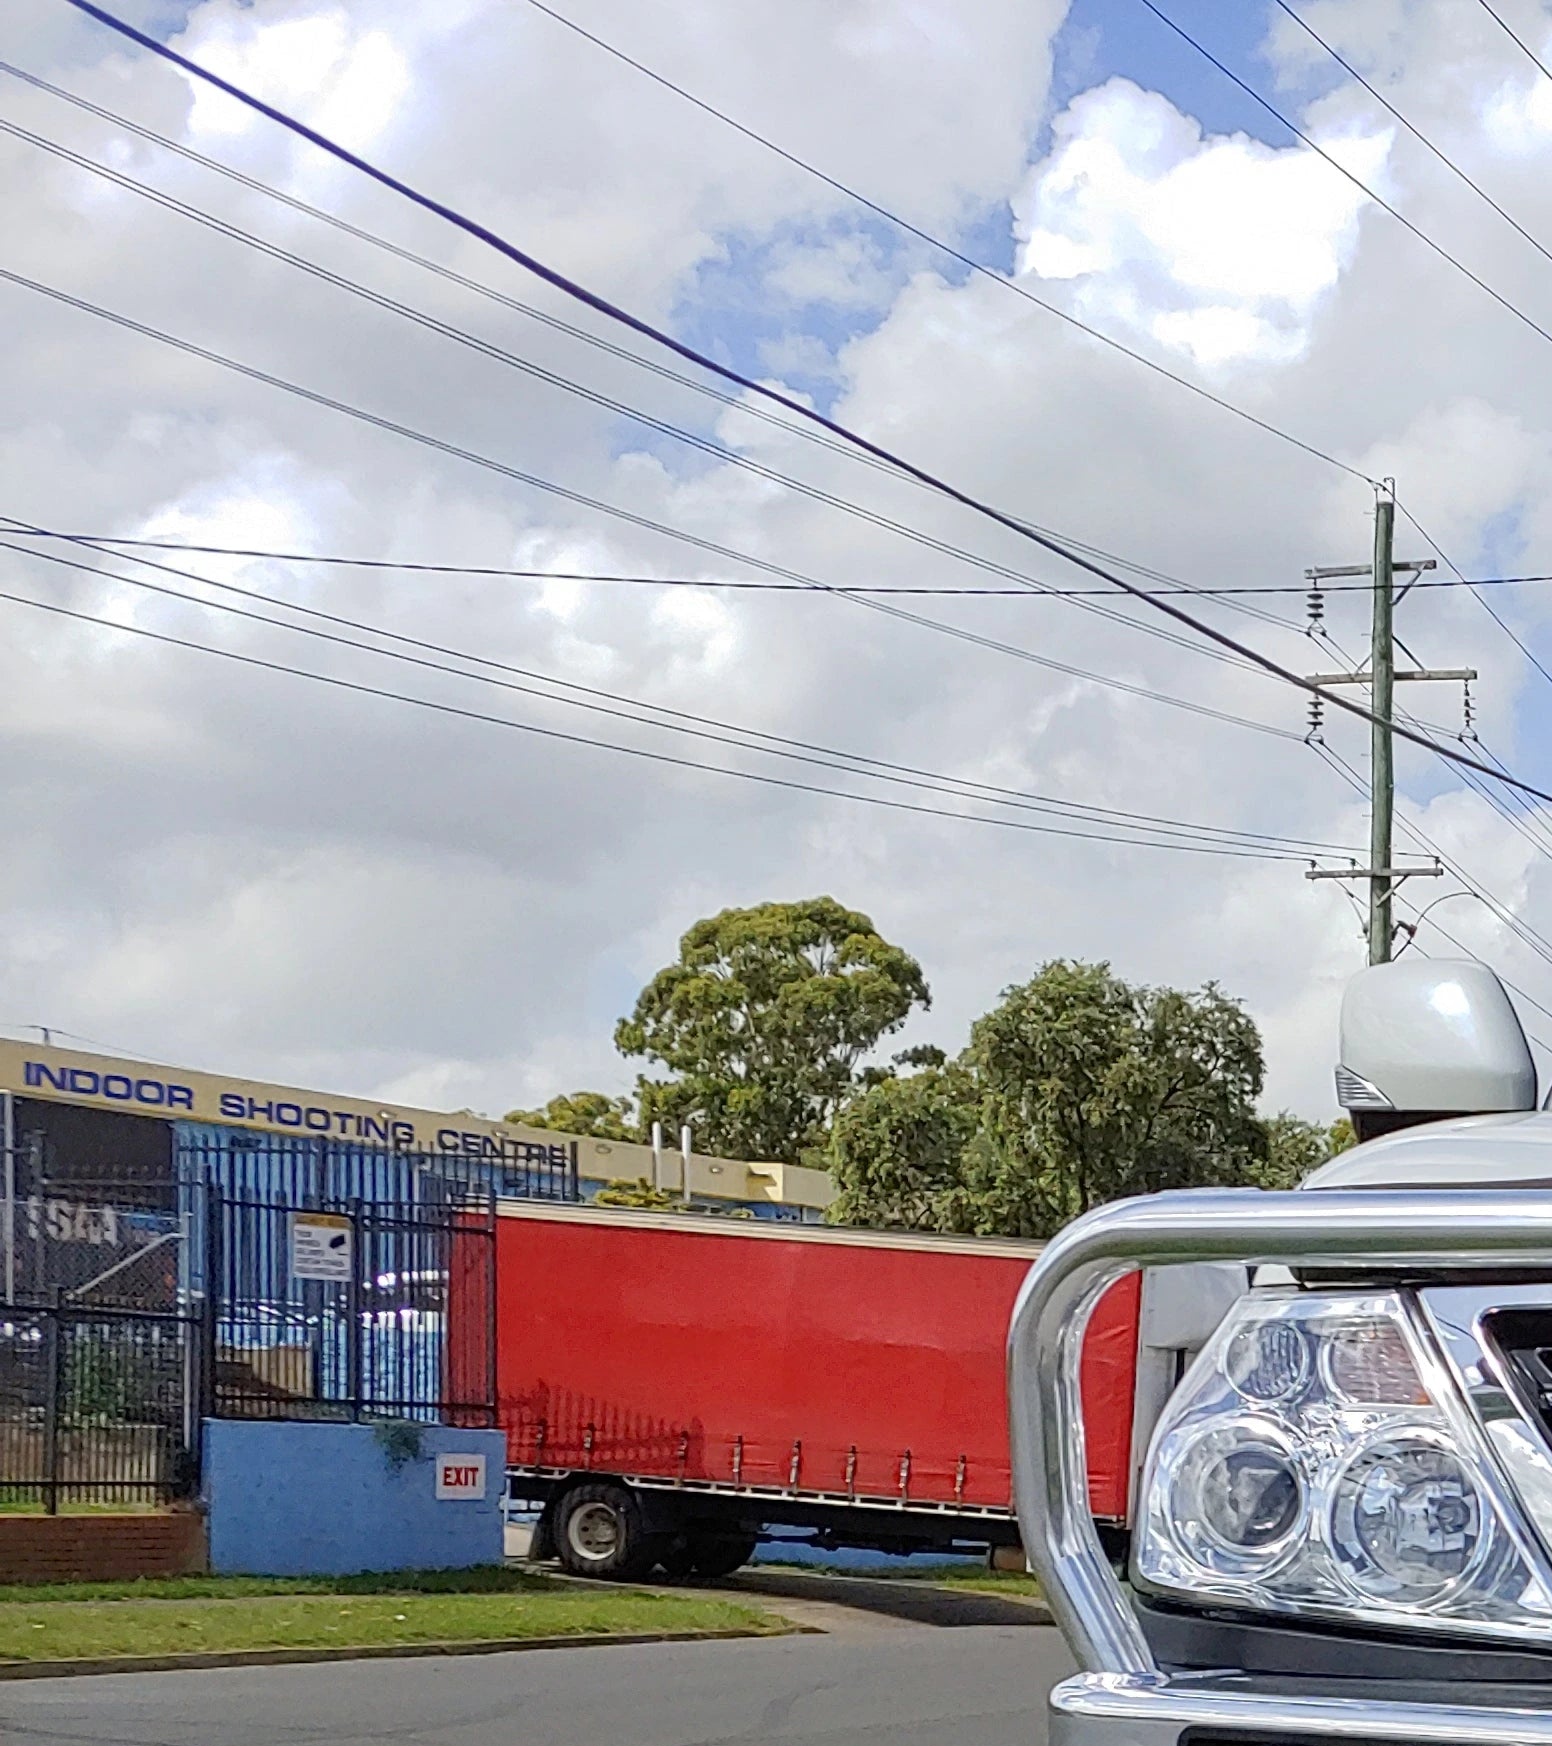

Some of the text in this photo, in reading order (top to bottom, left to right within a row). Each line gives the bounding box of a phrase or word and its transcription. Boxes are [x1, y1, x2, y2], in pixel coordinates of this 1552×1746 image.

[24, 1061, 566, 1168] INDOOR SHOOTING CENTRE
[442, 1466, 479, 1487] EXIT
